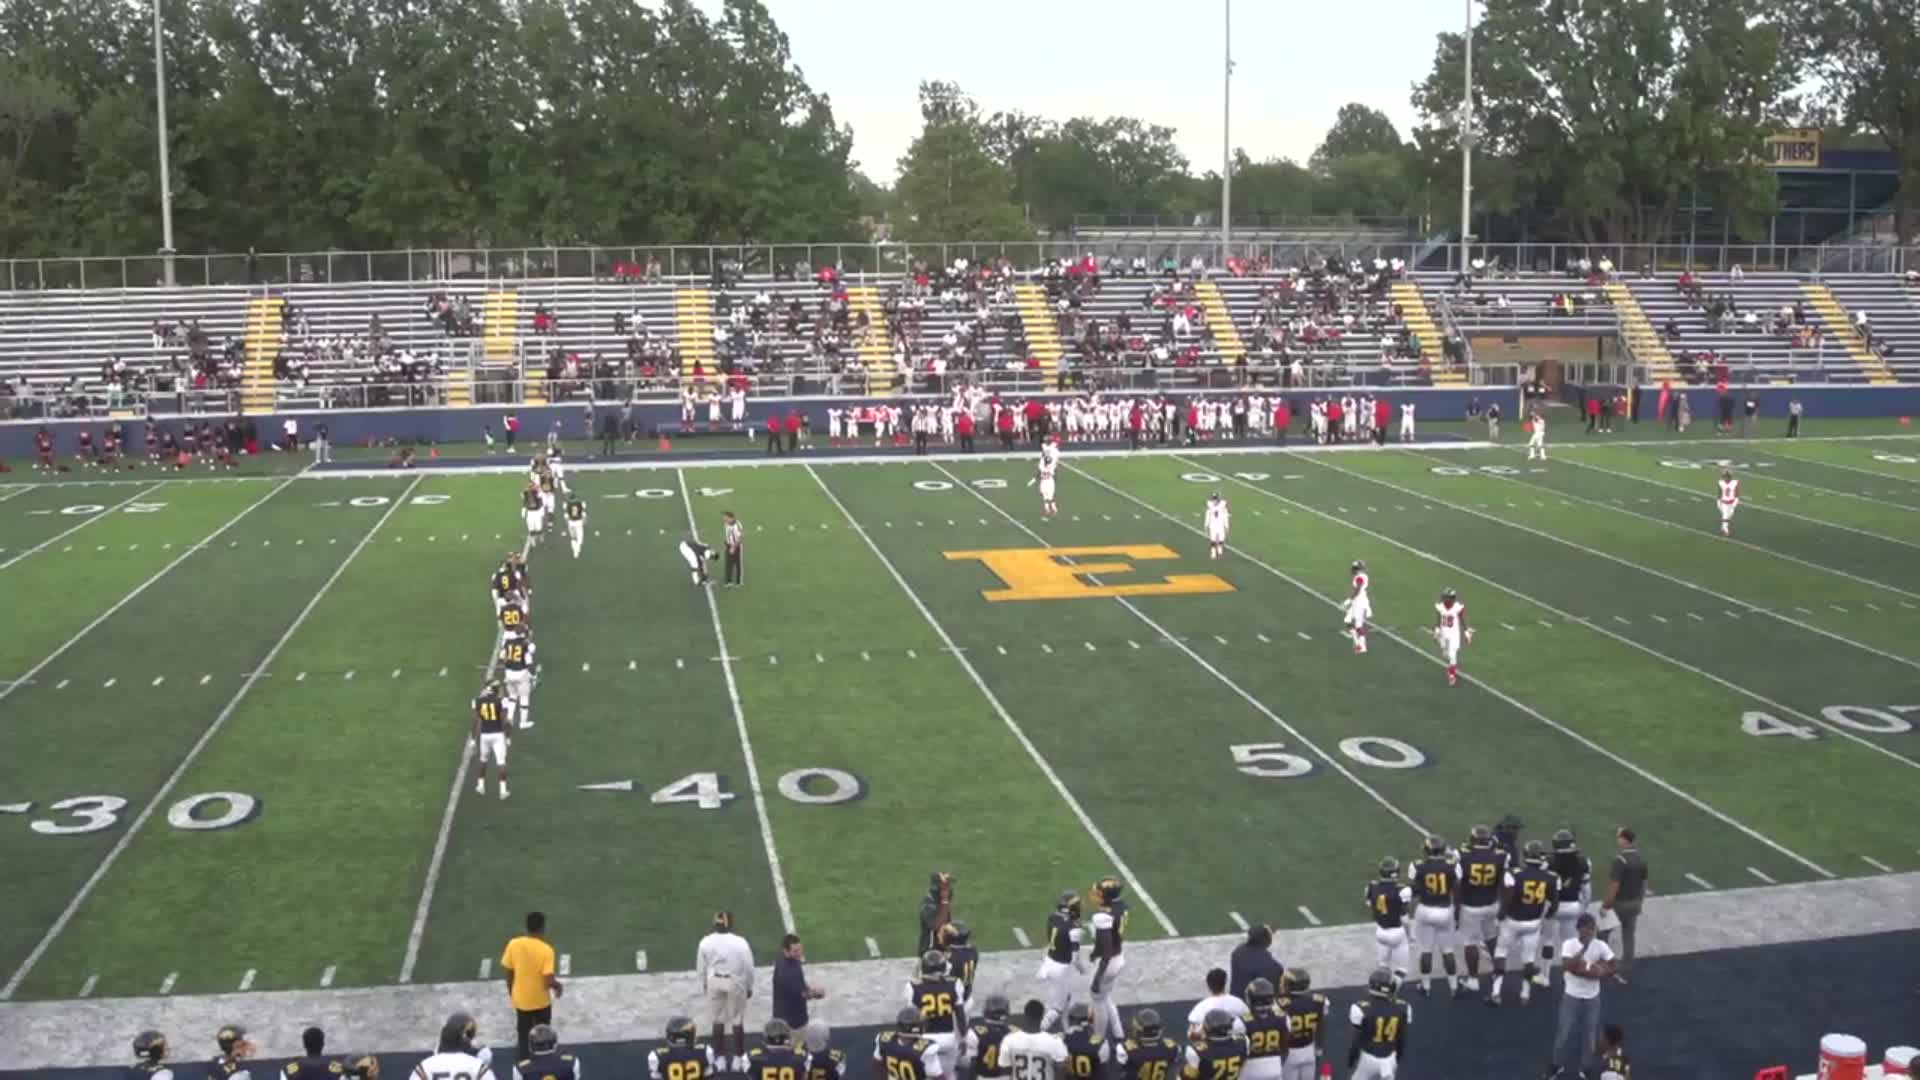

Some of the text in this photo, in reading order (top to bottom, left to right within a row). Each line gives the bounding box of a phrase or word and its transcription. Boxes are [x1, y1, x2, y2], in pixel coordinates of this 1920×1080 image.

[942, 544, 1238, 602] E
[503, 609, 520, 625] 20
[507, 644, 523, 662] 12
[480, 702, 497, 721] 41
[1425, 872, 1447, 894] 91
[1470, 863, 1496, 886] 52
[1522, 880, 1546, 905] 54
[1376, 894, 1387, 915] 4
[921, 993, 951, 1016] 26
[1251, 1030, 1281, 1051] 28
[1375, 1016, 1399, 1043] 14
[886, 1056, 916, 1080] 50
[1014, 1054, 1048, 1080] 23
[1212, 1057, 1241, 1080] 75
